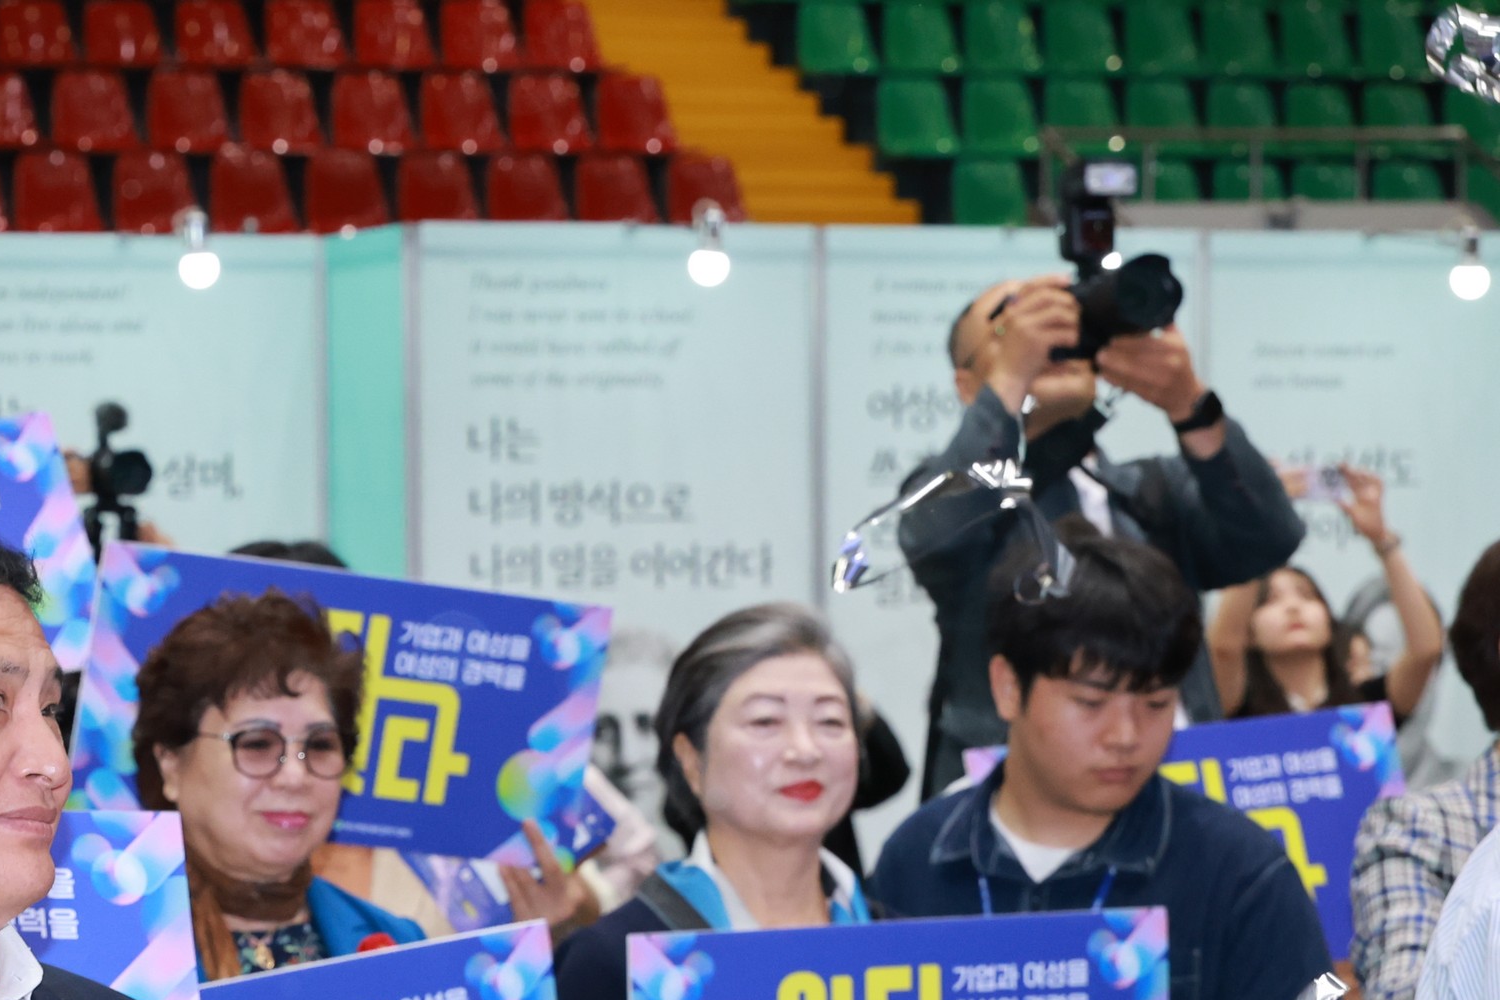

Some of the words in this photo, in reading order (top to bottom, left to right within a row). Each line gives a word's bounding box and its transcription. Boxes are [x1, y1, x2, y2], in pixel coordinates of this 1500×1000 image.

[866, 383, 957, 432] 여성
[467, 413, 540, 463] 나는
[467, 478, 543, 527] 나의
[548, 477, 695, 528] 방식으로
[468, 541, 543, 590] 나의
[549, 542, 623, 590] 일을
[631, 541, 774, 590] 이어간다
[952, 960, 1018, 993] 기업과
[1023, 958, 1089, 990] 여성을
